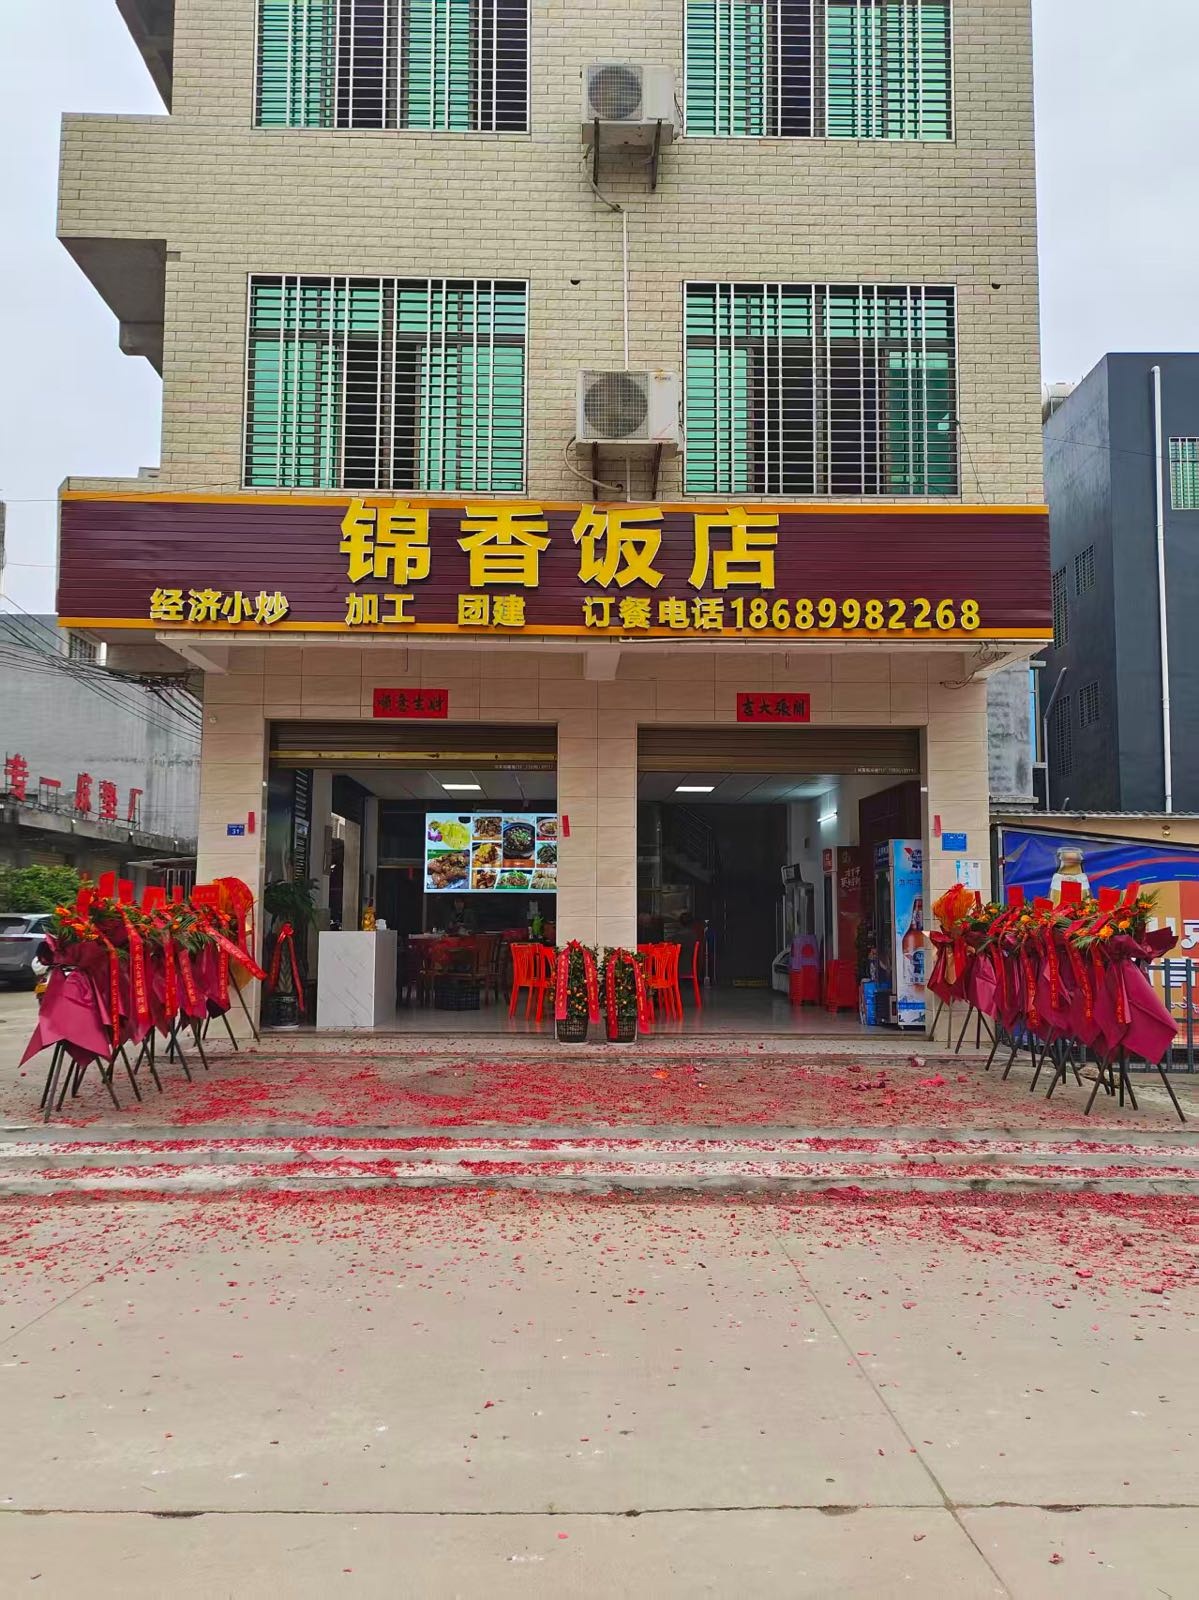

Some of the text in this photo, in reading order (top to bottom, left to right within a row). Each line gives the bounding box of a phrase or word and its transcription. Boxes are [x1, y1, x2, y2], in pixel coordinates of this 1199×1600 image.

[339, 498, 780, 590] 锦香饭店
[150, 588, 289, 624] 经济小炒
[345, 592, 416, 626] 加工
[458, 594, 527, 627] 团建
